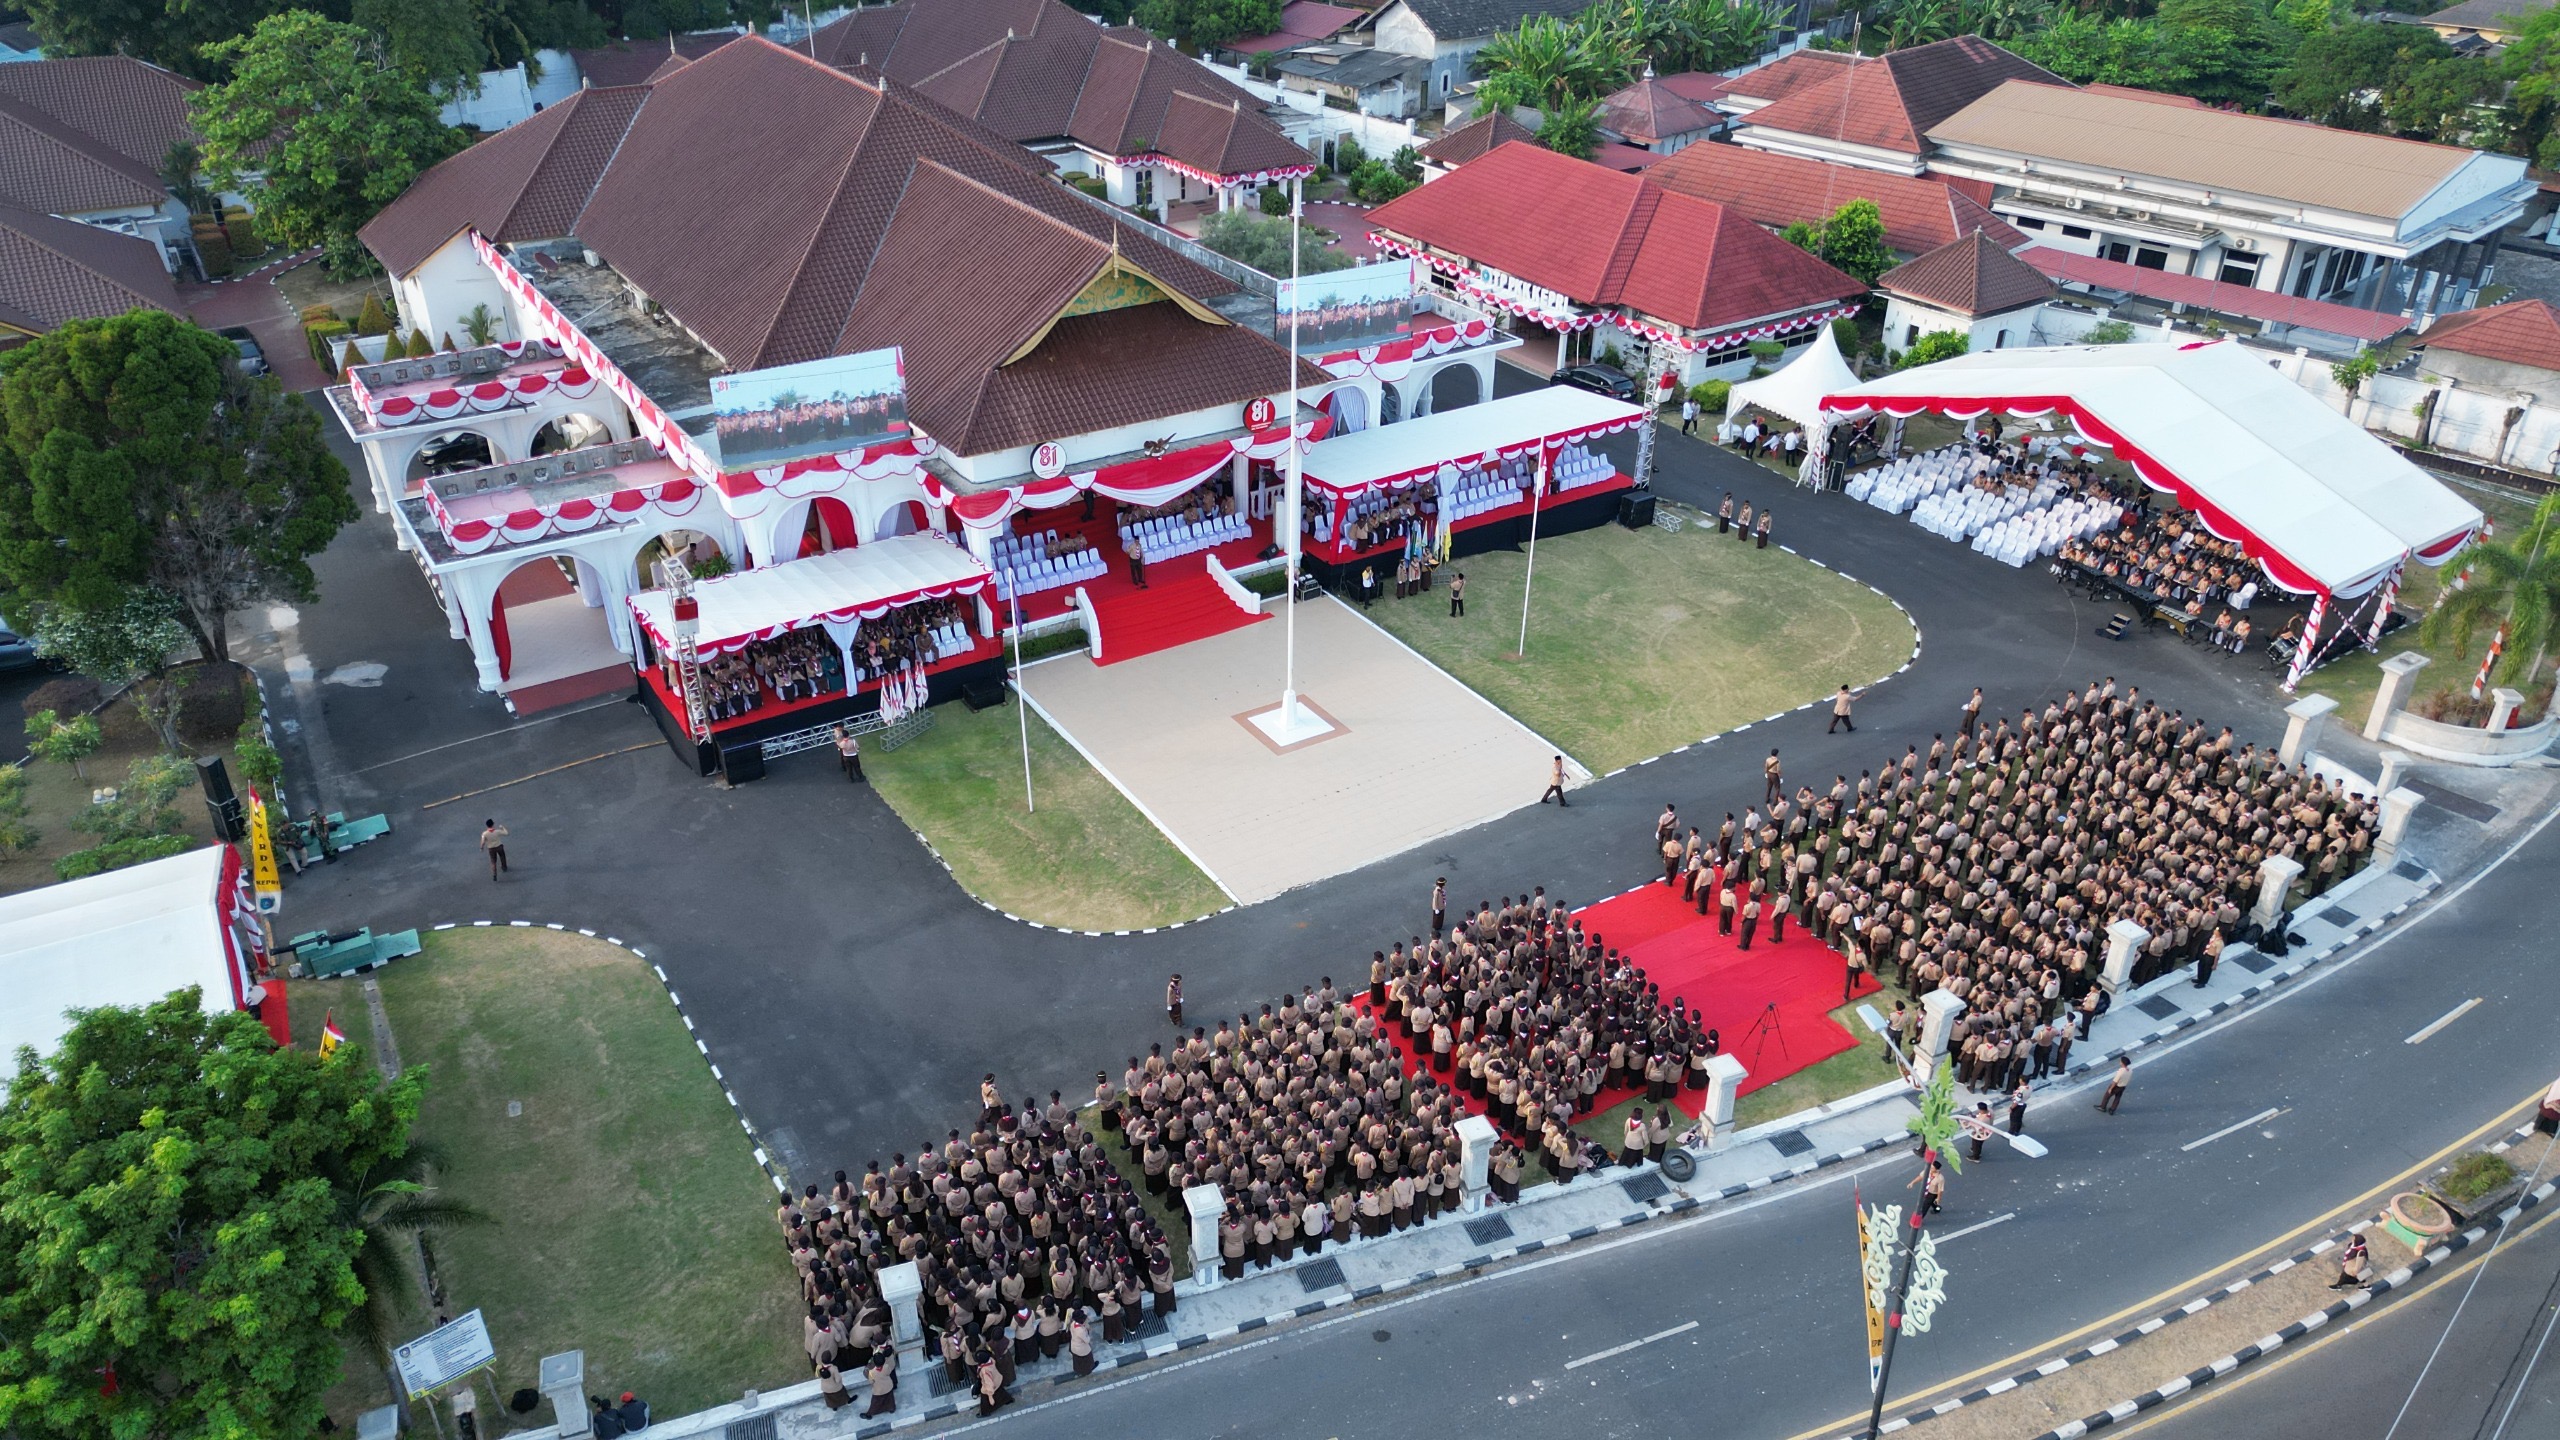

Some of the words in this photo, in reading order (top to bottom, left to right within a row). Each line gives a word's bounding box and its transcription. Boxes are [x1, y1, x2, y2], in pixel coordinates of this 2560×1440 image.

[1532, 285, 1569, 313] KEPRI
[717, 380, 729, 391] 81
[1251, 400, 1269, 422] 81
[1040, 445, 1058, 467] 81
[254, 811, 269, 872] KWARDA
